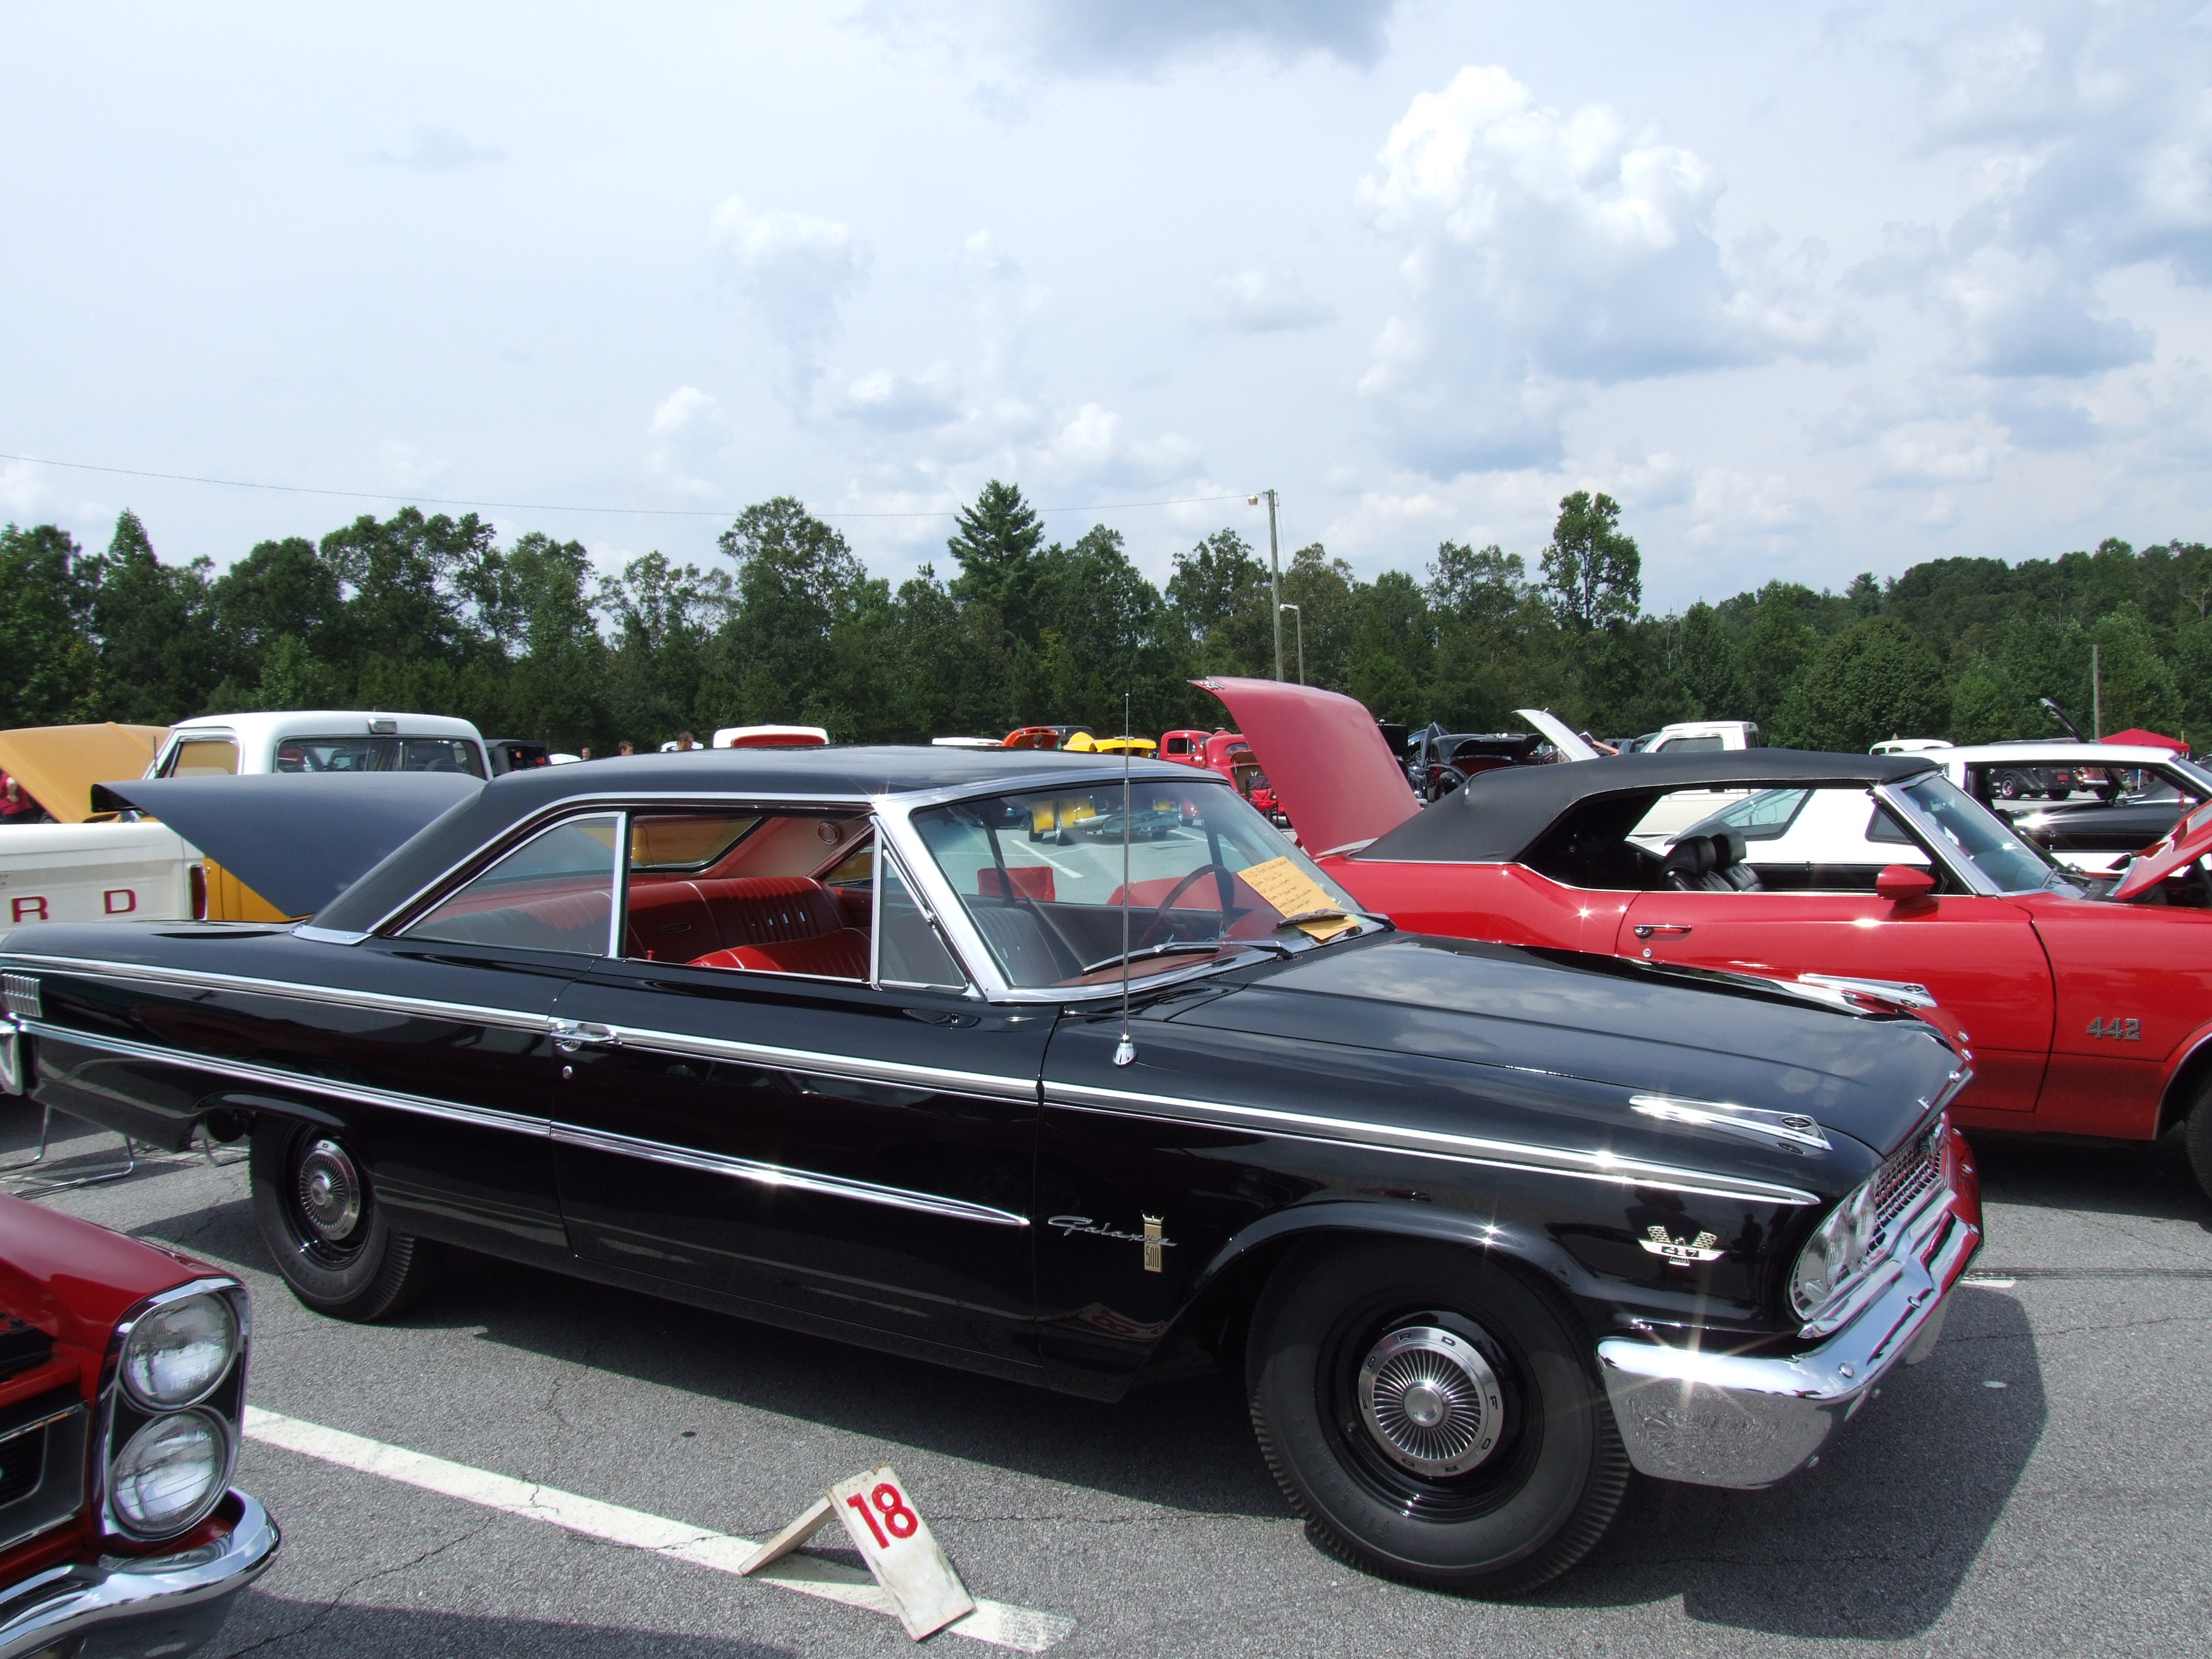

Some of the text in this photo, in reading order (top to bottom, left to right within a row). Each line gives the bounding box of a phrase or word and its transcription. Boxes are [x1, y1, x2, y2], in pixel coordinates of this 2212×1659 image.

[2086, 1016, 2141, 1041] 442
[1048, 1214, 1178, 1247] Galaxie
[1145, 1246, 1160, 1268] 500
[1663, 1247, 1698, 1257] 427
[846, 1483, 918, 1549] 18
